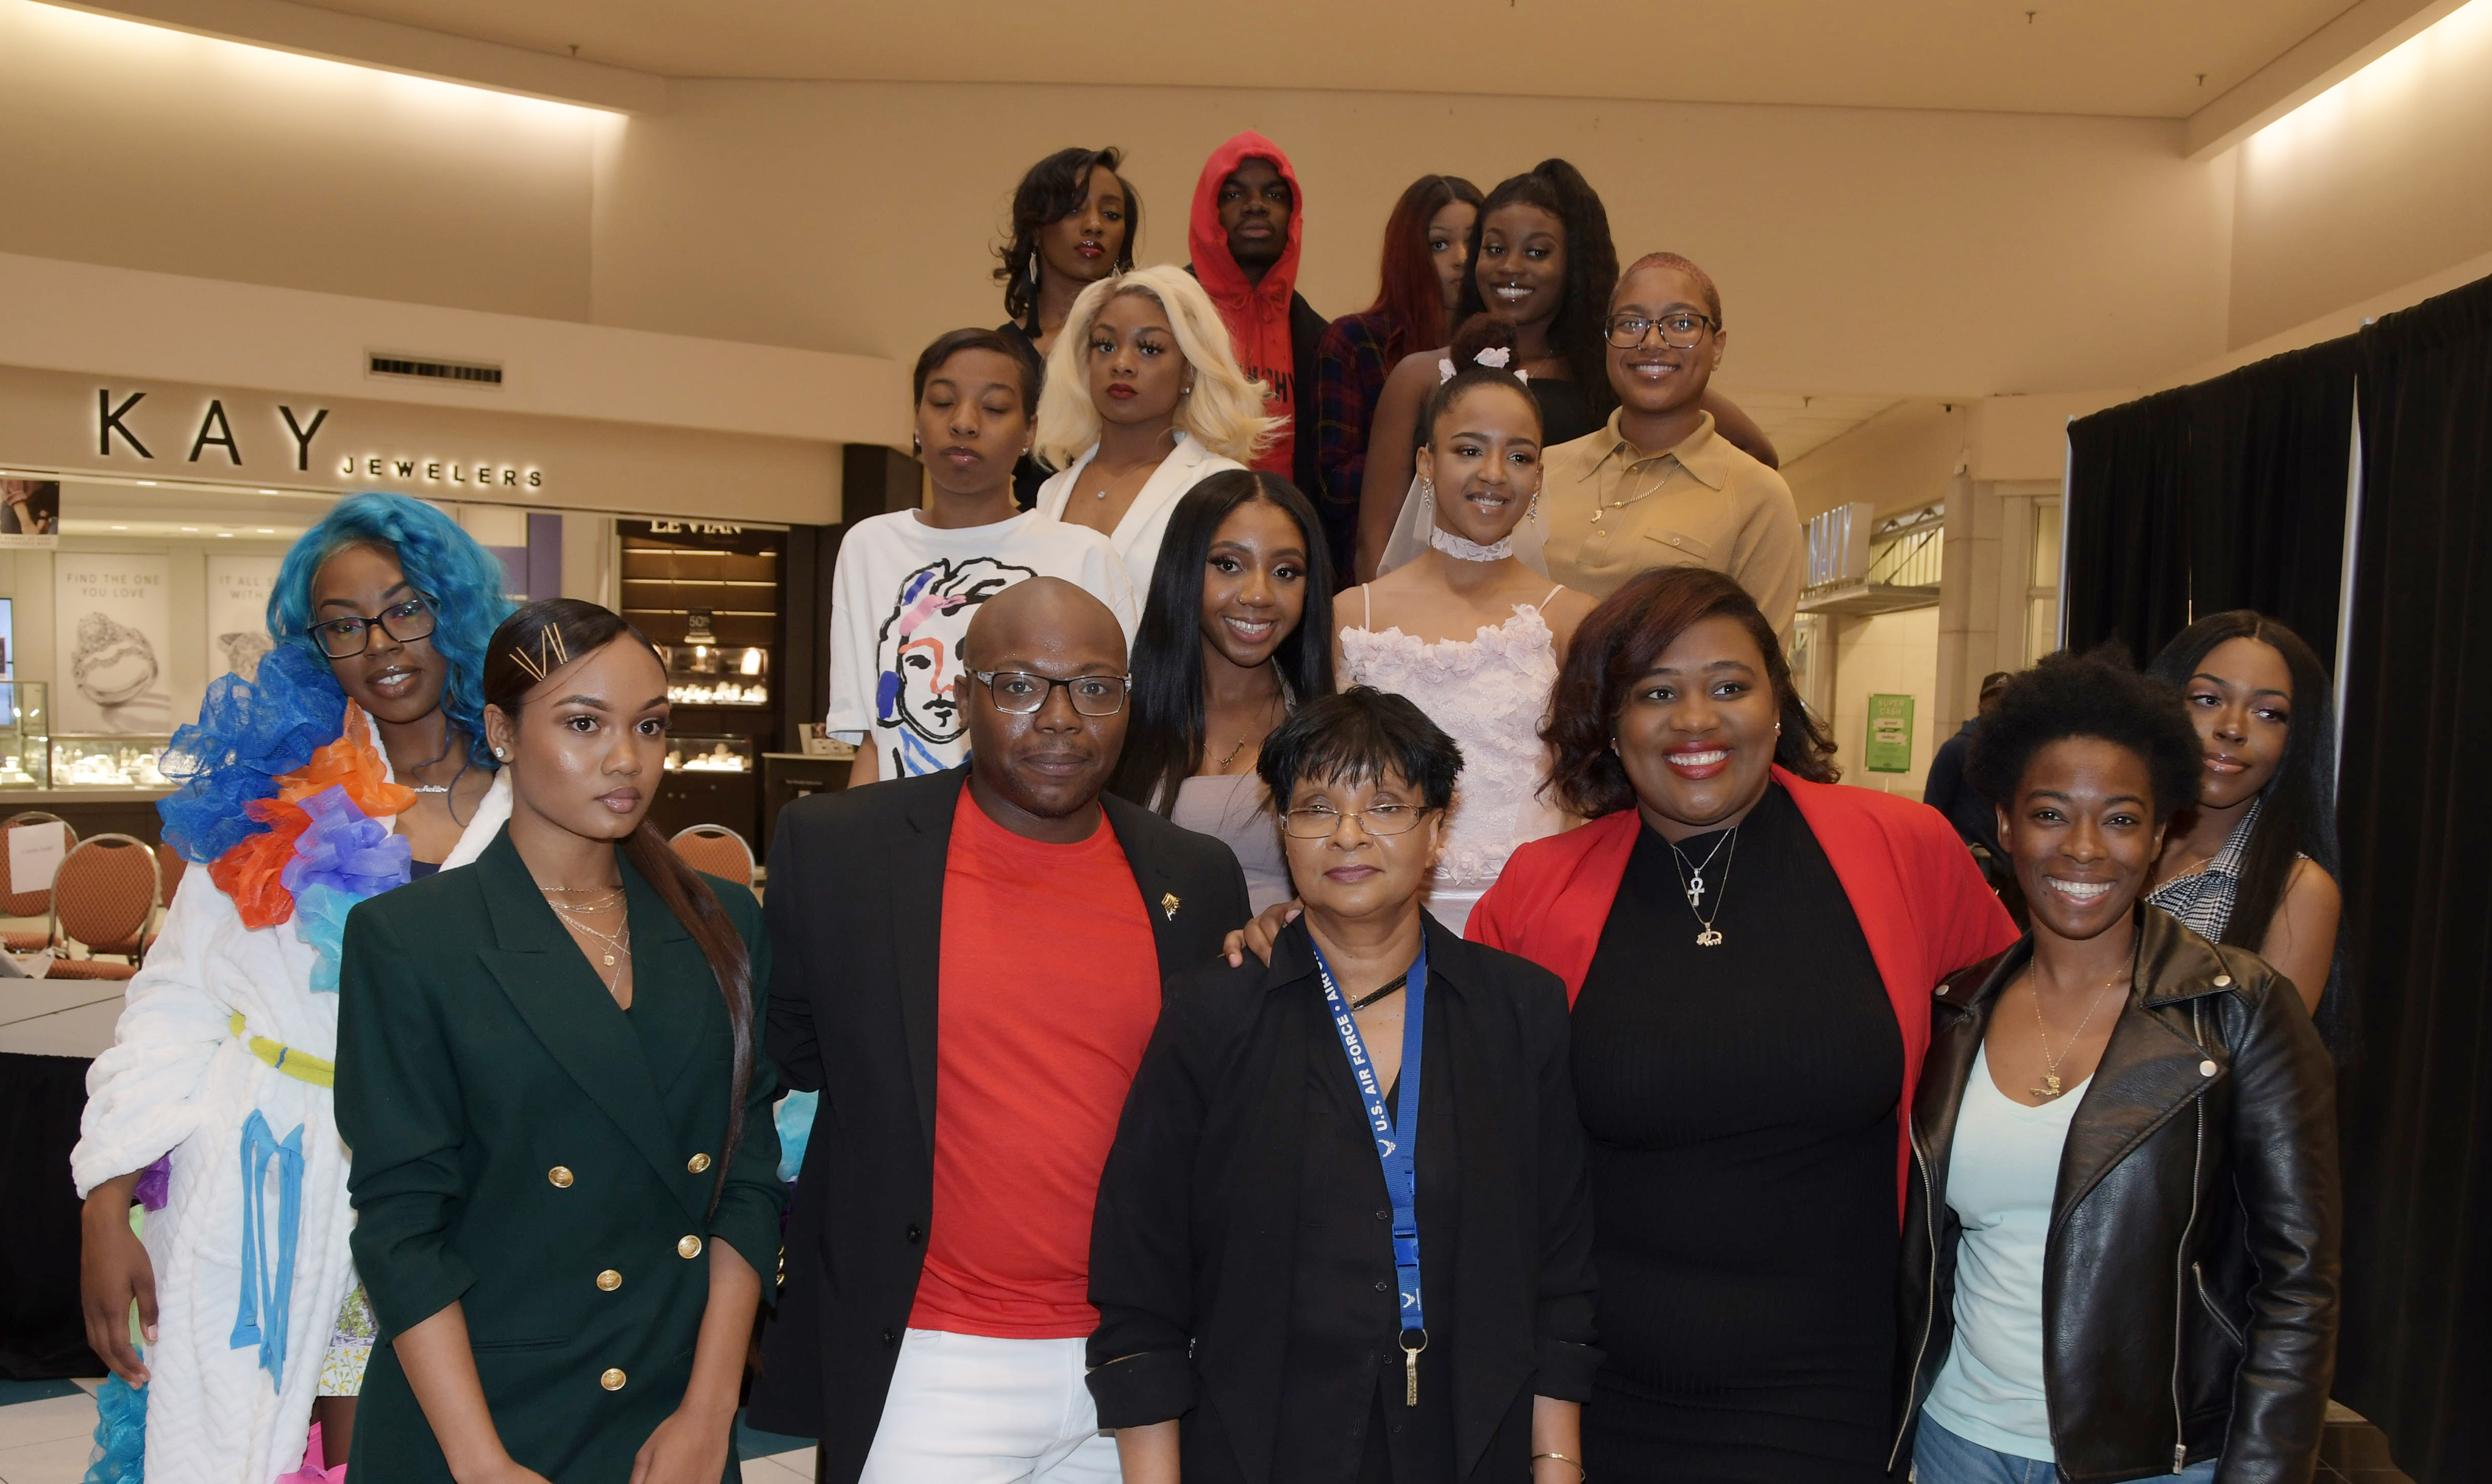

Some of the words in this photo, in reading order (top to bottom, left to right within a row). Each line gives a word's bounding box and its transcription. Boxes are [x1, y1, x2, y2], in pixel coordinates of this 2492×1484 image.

[99, 389, 329, 471] KAY
[343, 457, 541, 487] JEWELERS
[650, 520, 682, 533] LE
[67, 573, 97, 584] FIND
[104, 574, 126, 584] THE
[133, 575, 161, 586] ONE
[219, 575, 231, 585] IT
[237, 576, 259, 586] ALL
[82, 589, 106, 597] YOU
[113, 589, 146, 598] LOVE
[1878, 699, 1905, 708] SUPER
[1880, 708, 1902, 716] CASH
[1336, 1014, 1366, 1066] FORCE
[1358, 1068, 1377, 1095] AIR
[1371, 1100, 1388, 1131] U.S.
